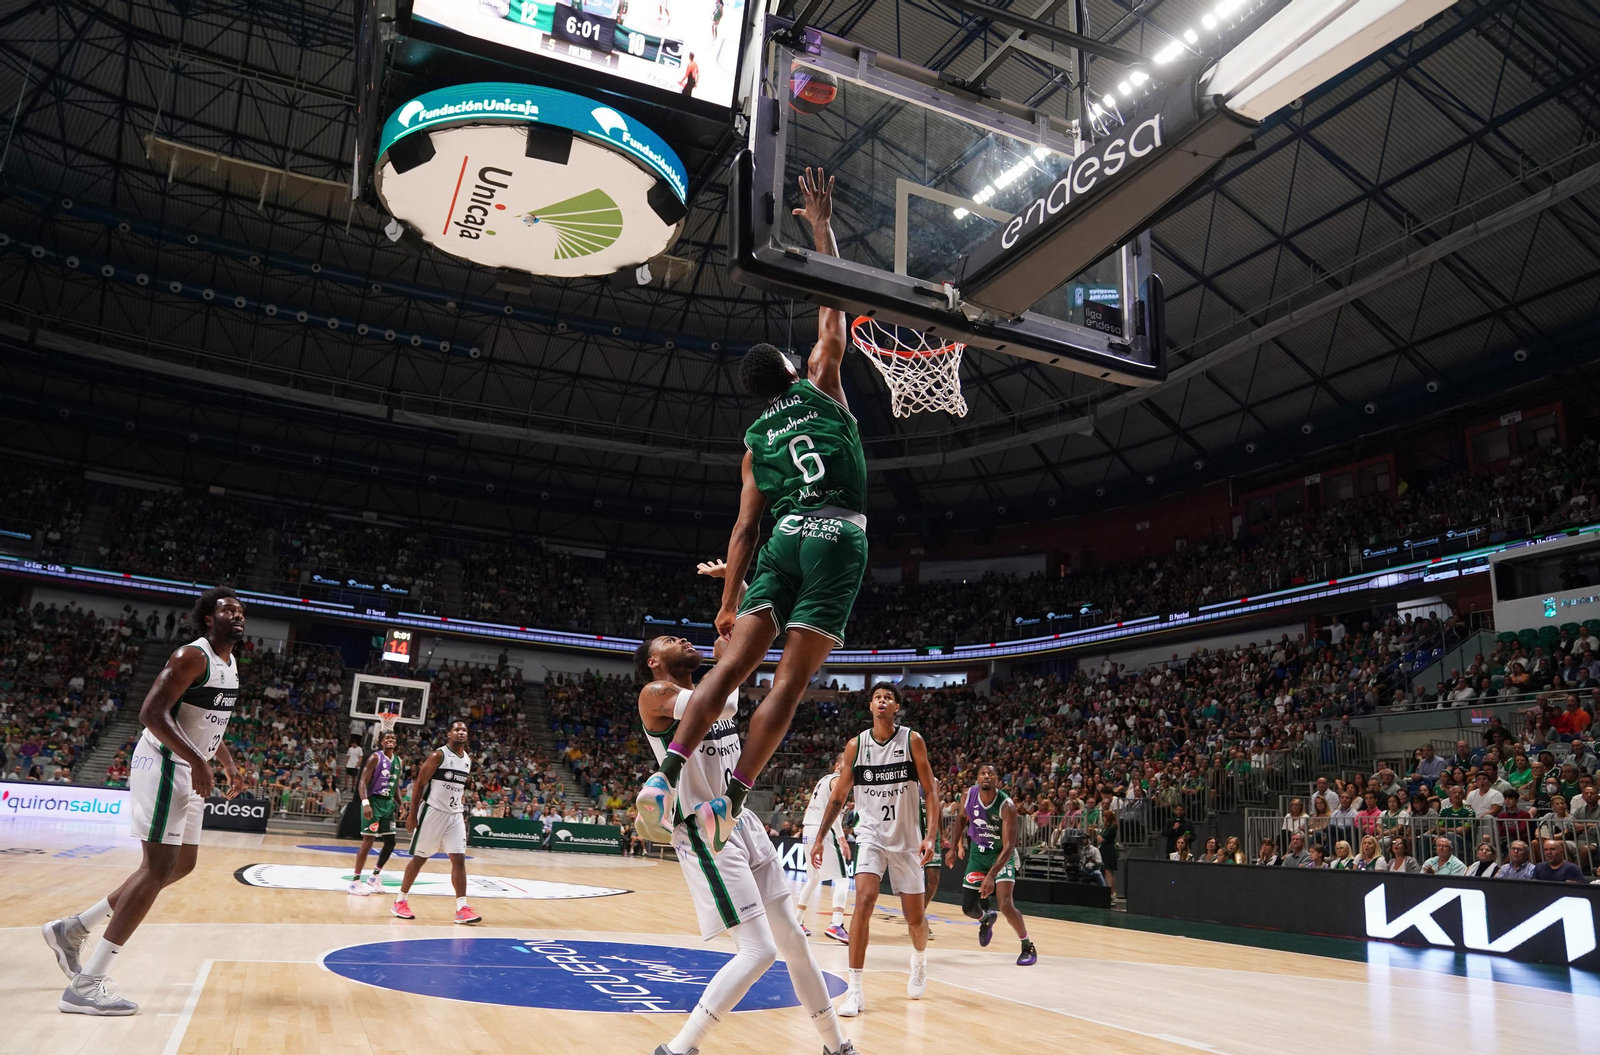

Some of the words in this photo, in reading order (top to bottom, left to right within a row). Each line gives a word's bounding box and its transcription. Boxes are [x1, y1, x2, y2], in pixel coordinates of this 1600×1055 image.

[519, 2, 539, 26] 12
[565, 16, 601, 41] 6:01
[548, 39, 556, 50] 5
[605, 54, 611, 66] 1
[627, 32, 646, 57] 10
[1001, 113, 1163, 250] endesa
[453, 166, 514, 241] Unicaja
[1085, 307, 1102, 320] liga
[1085, 318, 1121, 335] endesa
[764, 394, 803, 420] TAYLOR
[788, 434, 826, 484] 6
[803, 522, 819, 531] DEL
[821, 524, 841, 536] SOL
[393, 630, 411, 641] 6:01
[389, 640, 409, 655] 14
[205, 713, 229, 726] JOVENT
[875, 768, 909, 782] PROBITAS
[863, 784, 909, 798] JOVENTUT
[7, 795, 122, 814] quirónsalud
[203, 801, 265, 818] ndesa
[881, 804, 897, 822] 21
[1364, 883, 1597, 963] KIA
